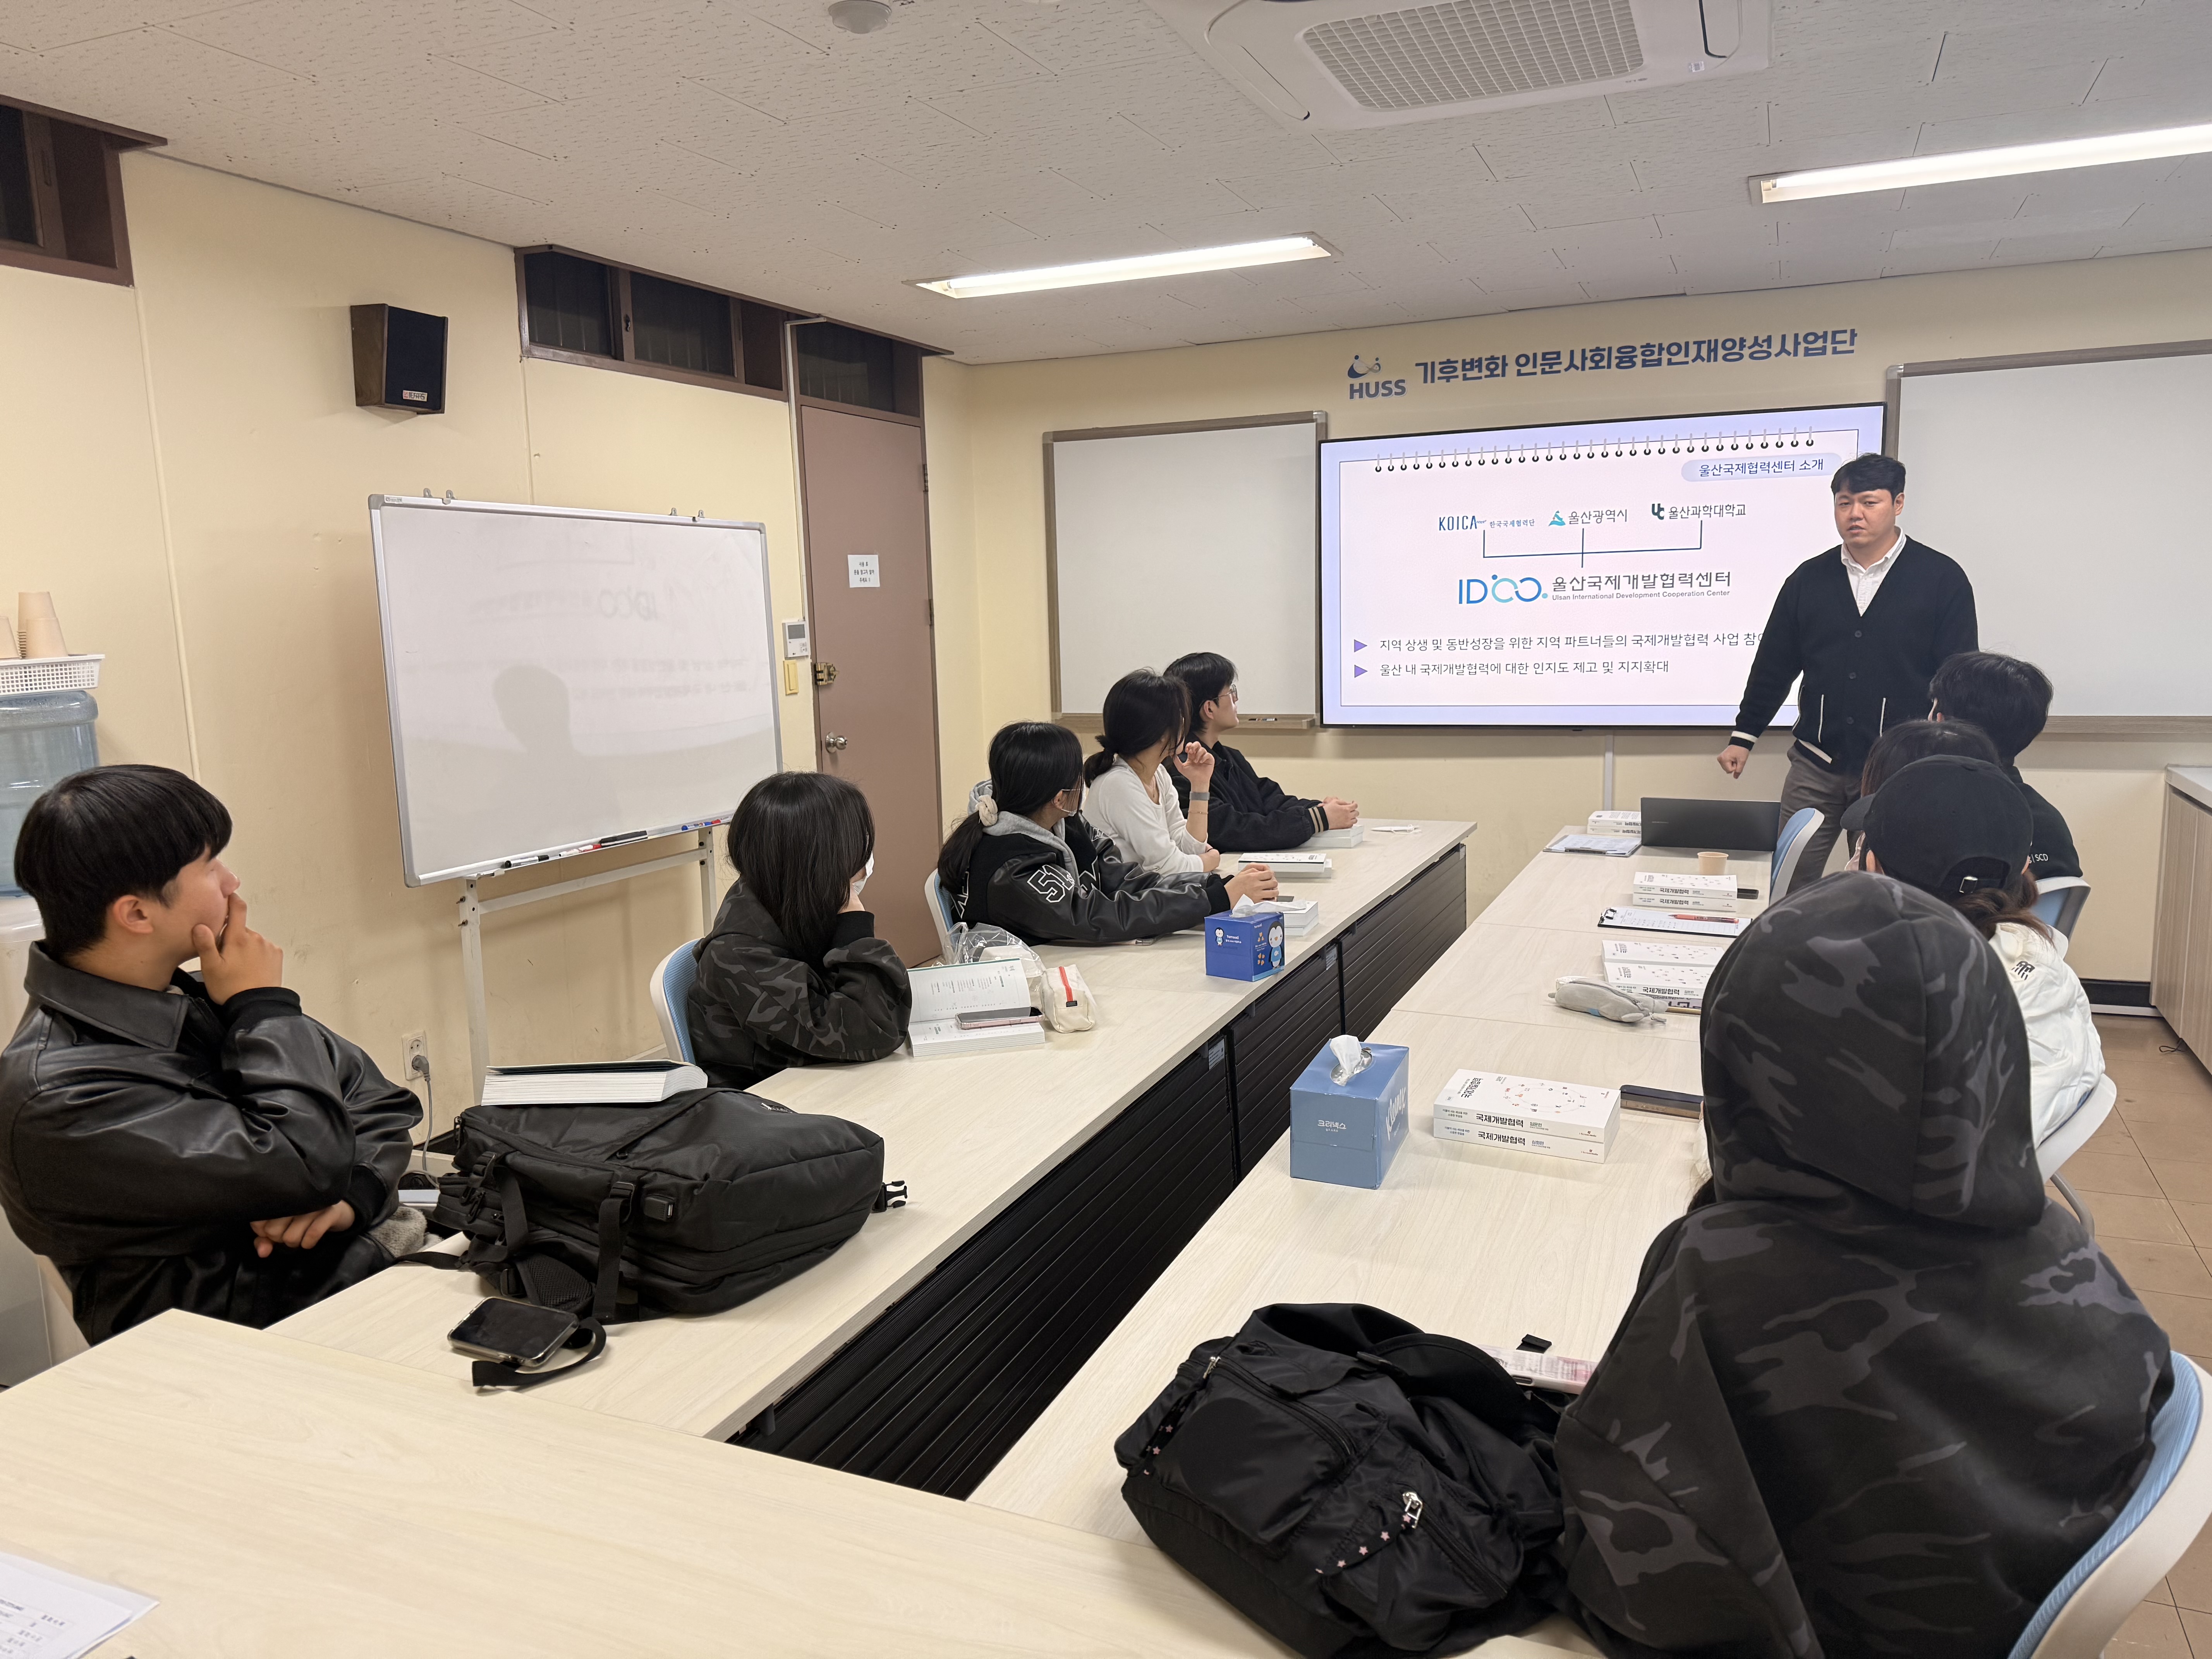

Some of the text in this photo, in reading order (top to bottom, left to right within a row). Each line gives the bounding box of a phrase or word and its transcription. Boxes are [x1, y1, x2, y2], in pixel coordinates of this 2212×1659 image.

[1415, 329, 1858, 384] 기후변화 인문사회융합인재양성사업단
[1349, 379, 1407, 400] HUSS
[1699, 459, 1824, 477] 울산국제협력센터 소개
[1568, 509, 1628, 525] 울산광역시
[1669, 504, 1746, 519] 울산과학대학교
[1439, 515, 1477, 531] KOICA
[1490, 519, 1535, 528] 한국국제협력단
[1552, 572, 1731, 592] 울산국제개발협력센터
[1380, 639, 1401, 651] 지역
[1405, 639, 1428, 651] 상생
[1432, 639, 1442, 650] 및
[1446, 638, 1505, 651] 동반성장을
[1509, 637, 1533, 649] 위한
[1537, 636, 1561, 649] 지역
[1565, 634, 1627, 648] 파트너들의
[1631, 633, 1709, 647] 국제개발협력
[1713, 633, 1739, 646] 사업
[1380, 660, 1669, 676] 울산 내 국제개발협력에 대한 인지도 제고 및 지지확대
[1642, 987, 1680, 995] 국제개발협력
[1318, 1120, 1346, 1129] 크리넥스
[1476, 1113, 1524, 1127] 국제개발협력
[1478, 1131, 1525, 1146] 국제개발협력
